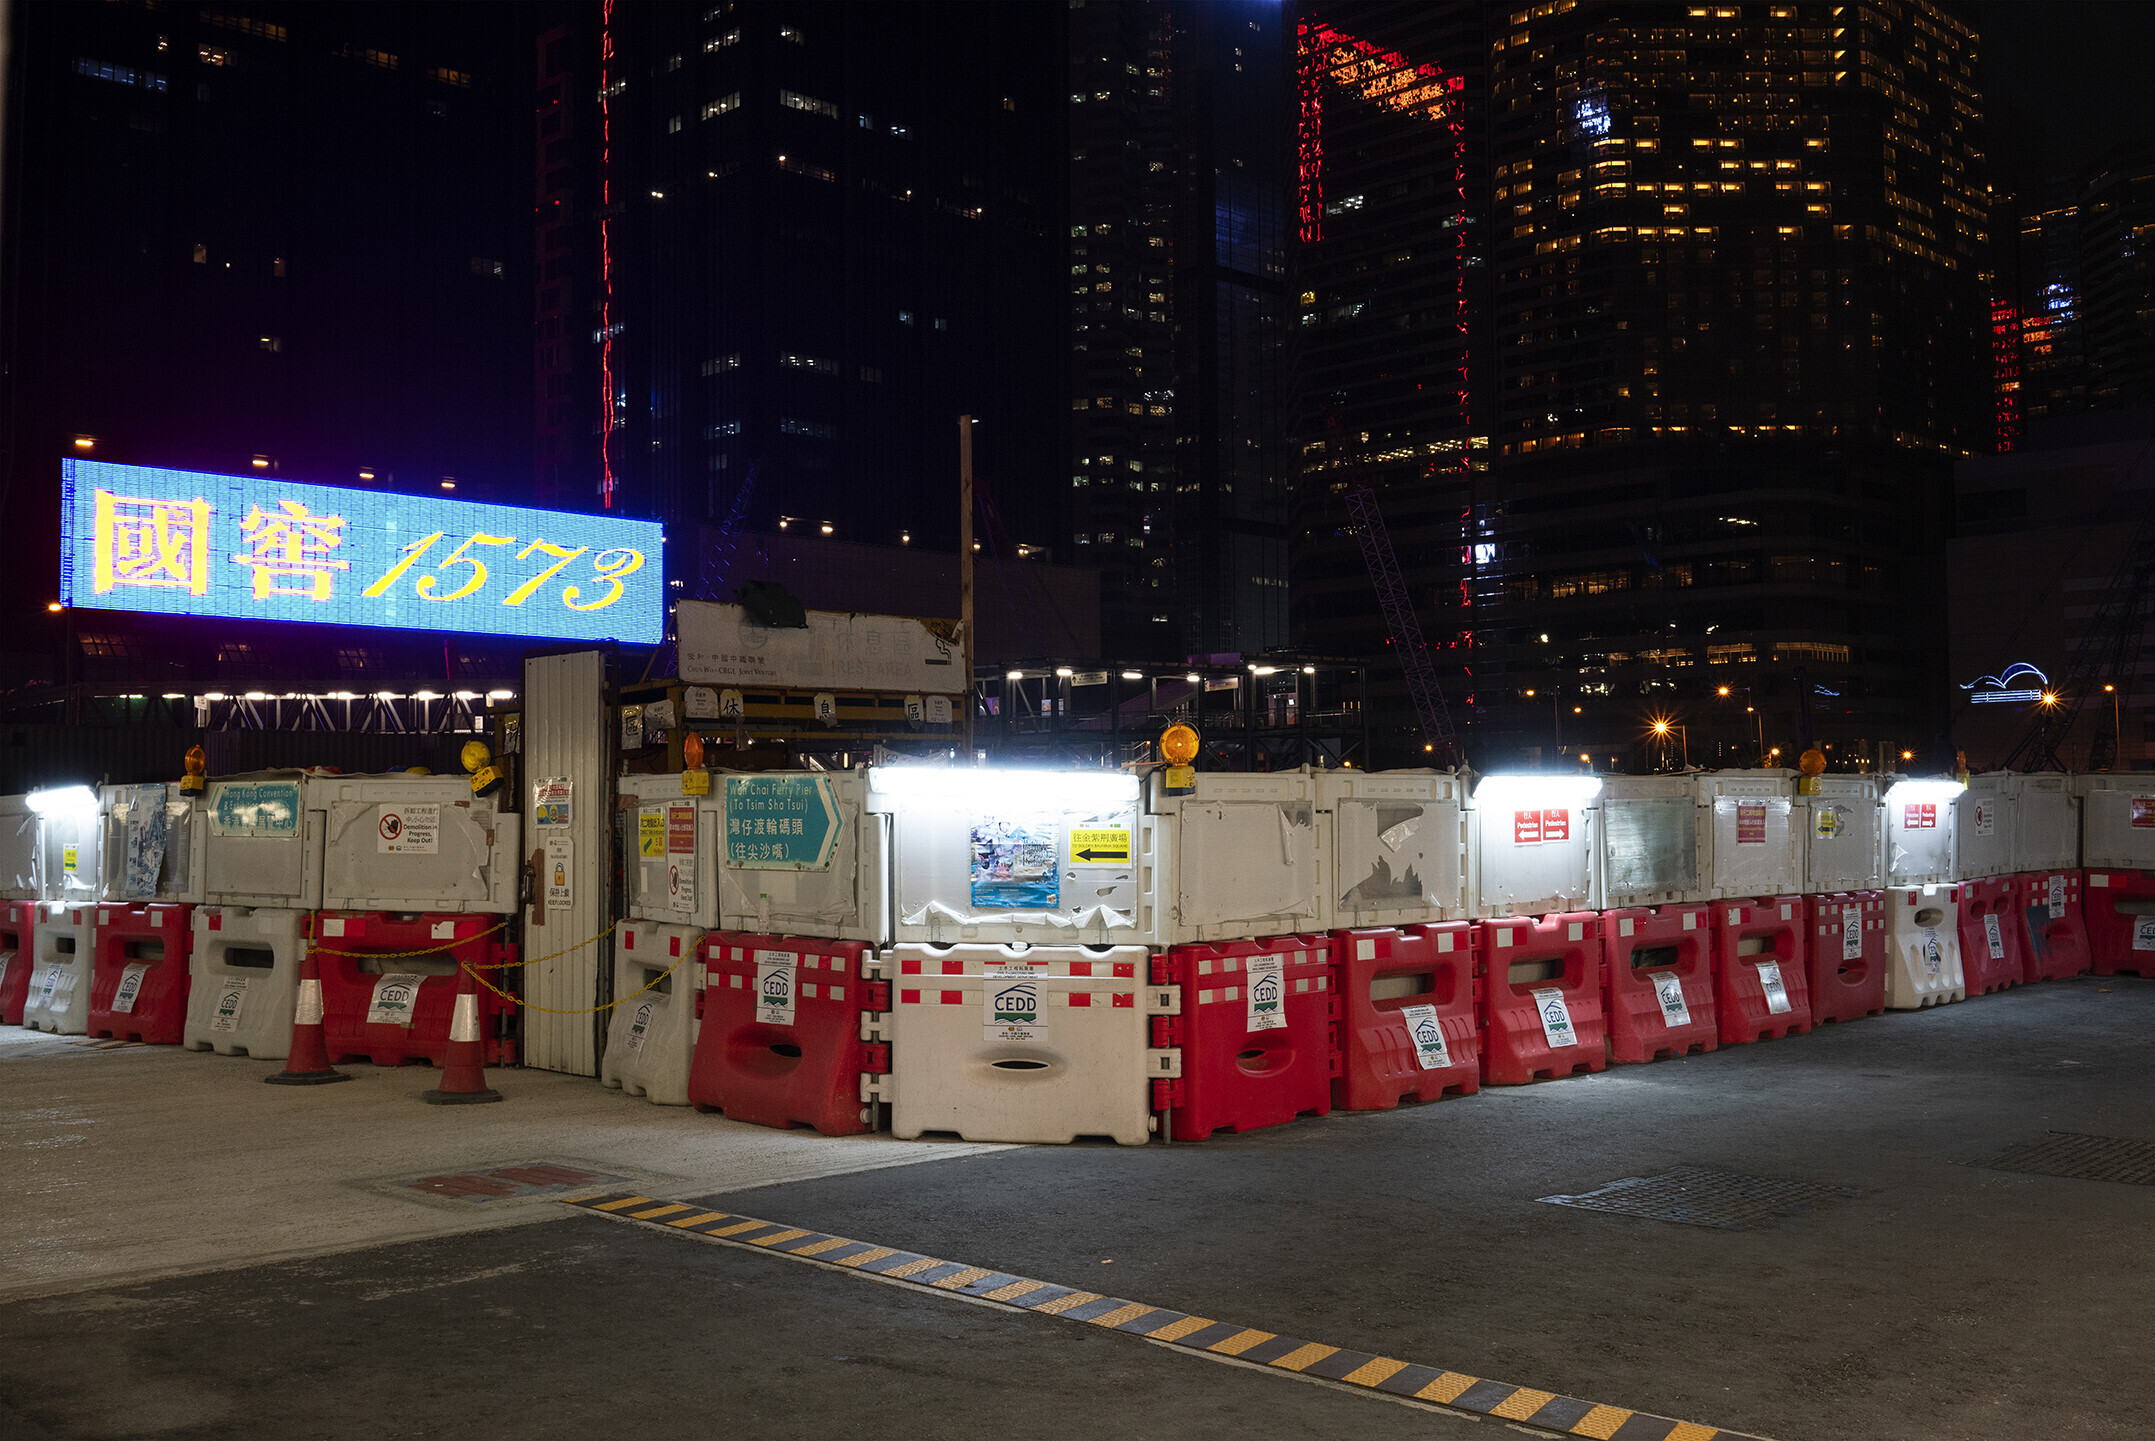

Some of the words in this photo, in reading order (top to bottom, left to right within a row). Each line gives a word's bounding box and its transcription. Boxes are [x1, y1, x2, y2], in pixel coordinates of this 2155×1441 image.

[94, 488, 351, 601] 國窖
[361, 531, 645, 611] 1573
[722, 698, 741, 715] 休
[907, 702, 921, 721] 區
[241, 788, 257, 800] Kong
[259, 787, 293, 799] Convention
[729, 783, 748, 796] Wan
[750, 783, 769, 795] Chai
[771, 783, 793, 798] Ferry
[796, 783, 813, 795] Pier
[729, 799, 743, 813] (To
[746, 799, 765, 810] Tsim
[768, 799, 784, 810] Sha
[787, 799, 808, 813] Tsui)
[729, 817, 804, 836] 灣仔渡輪碼頭
[408, 830, 432, 838] Progress,
[763, 981, 789, 996] CEDD
[1253, 986, 1278, 1002] CEDD
[380, 990, 410, 1002] CEDD
[1661, 991, 1681, 1004] CEDD
[221, 999, 238, 1009] CEDD
[994, 997, 1037, 1012] CEDD
[1544, 1010, 1566, 1024] CEDD
[1416, 1030, 1439, 1044] CEDD
